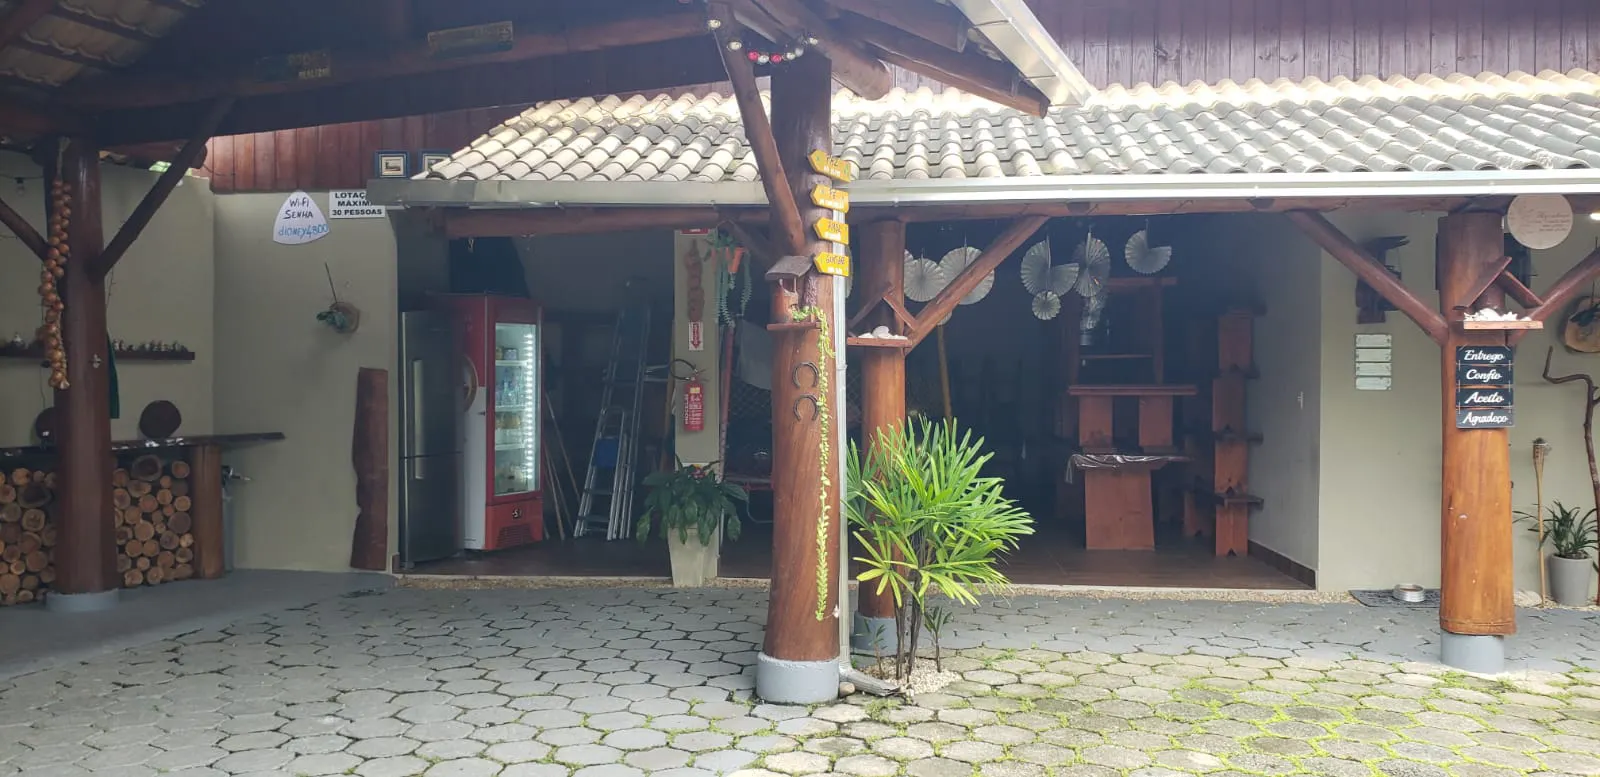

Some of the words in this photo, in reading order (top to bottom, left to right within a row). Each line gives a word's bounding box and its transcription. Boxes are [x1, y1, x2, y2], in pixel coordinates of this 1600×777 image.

[337, 199, 373, 207] MÁXIM
[344, 208, 382, 216] PESSOAS
[1463, 350, 1505, 363] Entrego
[1466, 369, 1503, 382] Confio
[1464, 392, 1504, 404] Aceito
